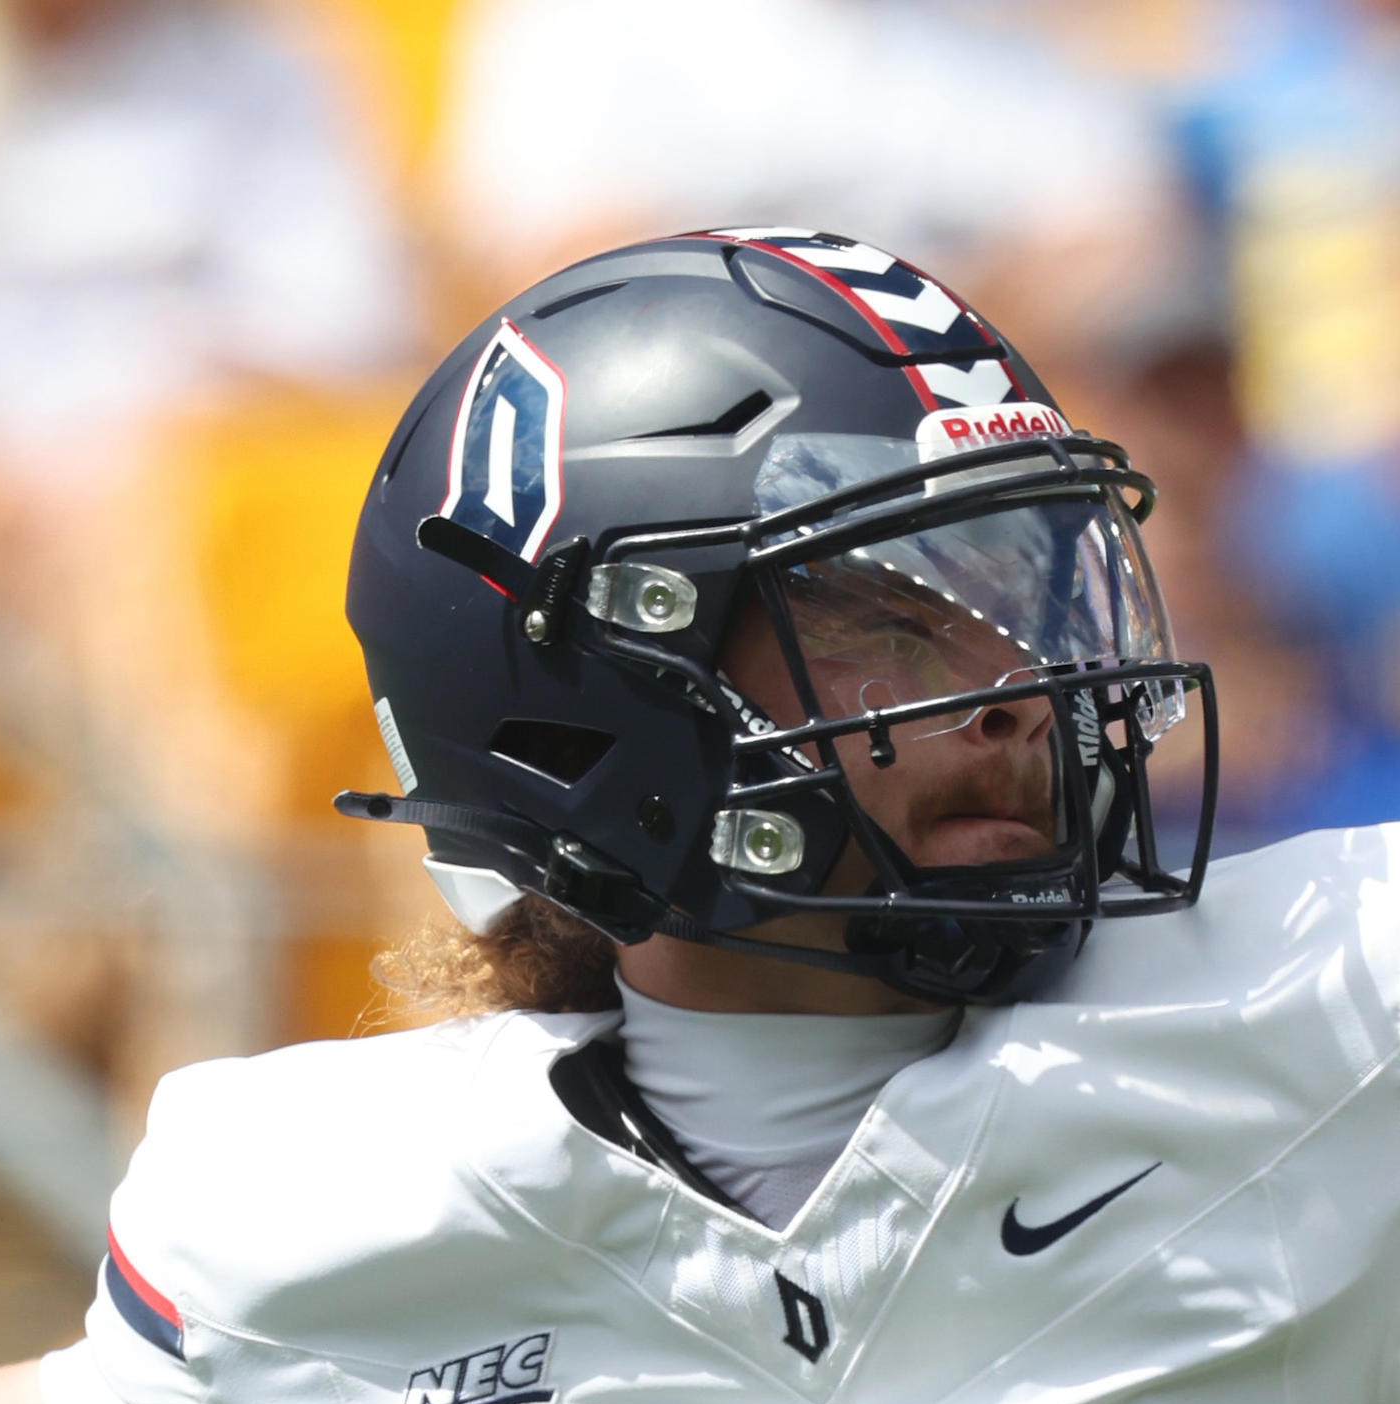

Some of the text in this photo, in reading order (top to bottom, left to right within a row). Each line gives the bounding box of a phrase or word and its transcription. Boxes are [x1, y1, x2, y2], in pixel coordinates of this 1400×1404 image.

[940, 409, 1065, 448] Riddell
[1072, 687, 1100, 766] Ridde
[774, 1268, 830, 1365] D
